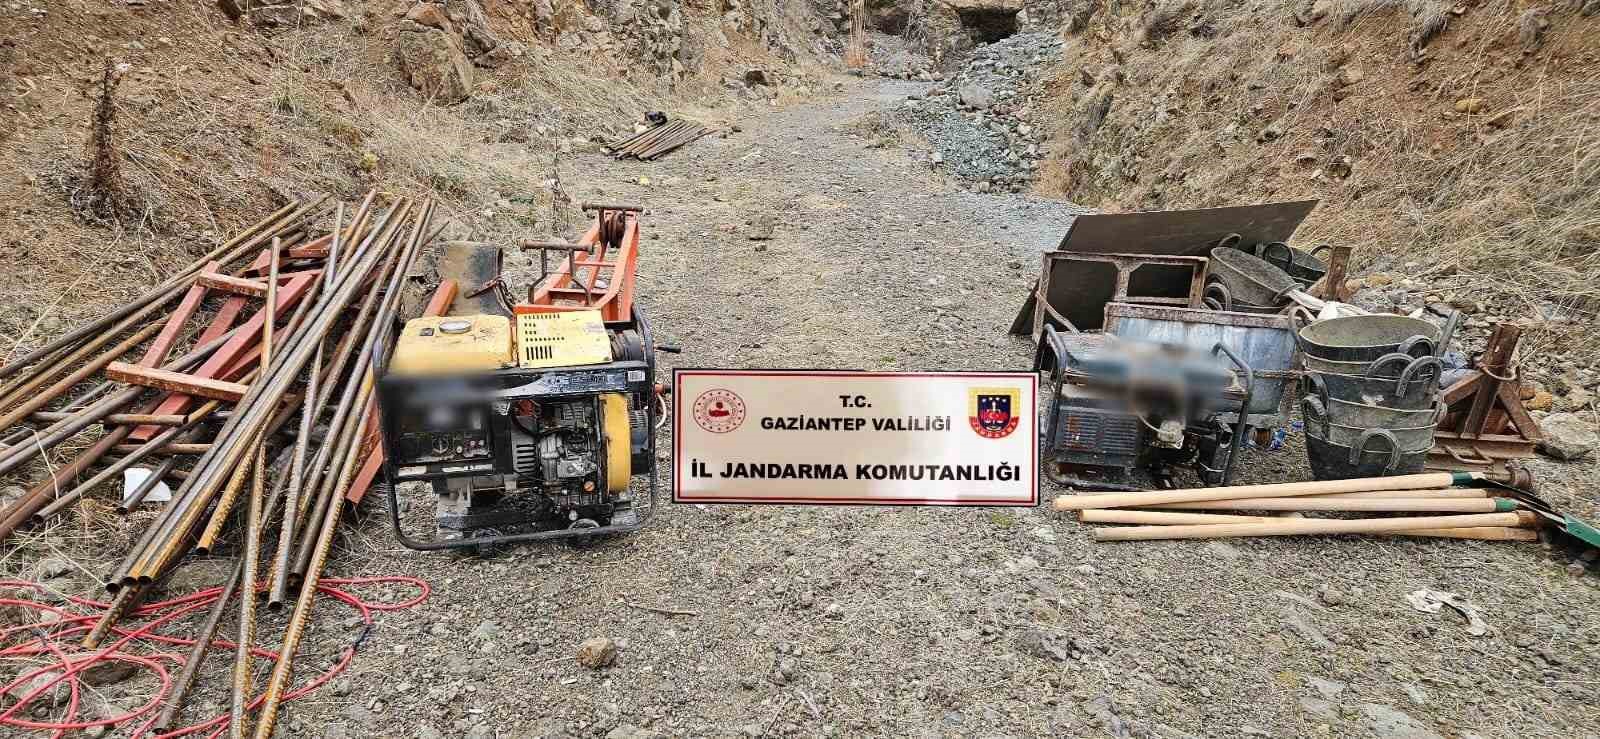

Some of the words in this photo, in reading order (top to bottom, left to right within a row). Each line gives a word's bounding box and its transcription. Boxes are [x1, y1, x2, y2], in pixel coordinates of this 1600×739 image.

[839, 395, 872, 408] T.C.
[760, 415, 866, 431] GAZİANTEP
[871, 415, 951, 431] VALİLİĞİ
[691, 458, 713, 478] İL
[719, 462, 849, 479] JANDARMA
[855, 461, 1020, 481] KOMUTANLIĞI
